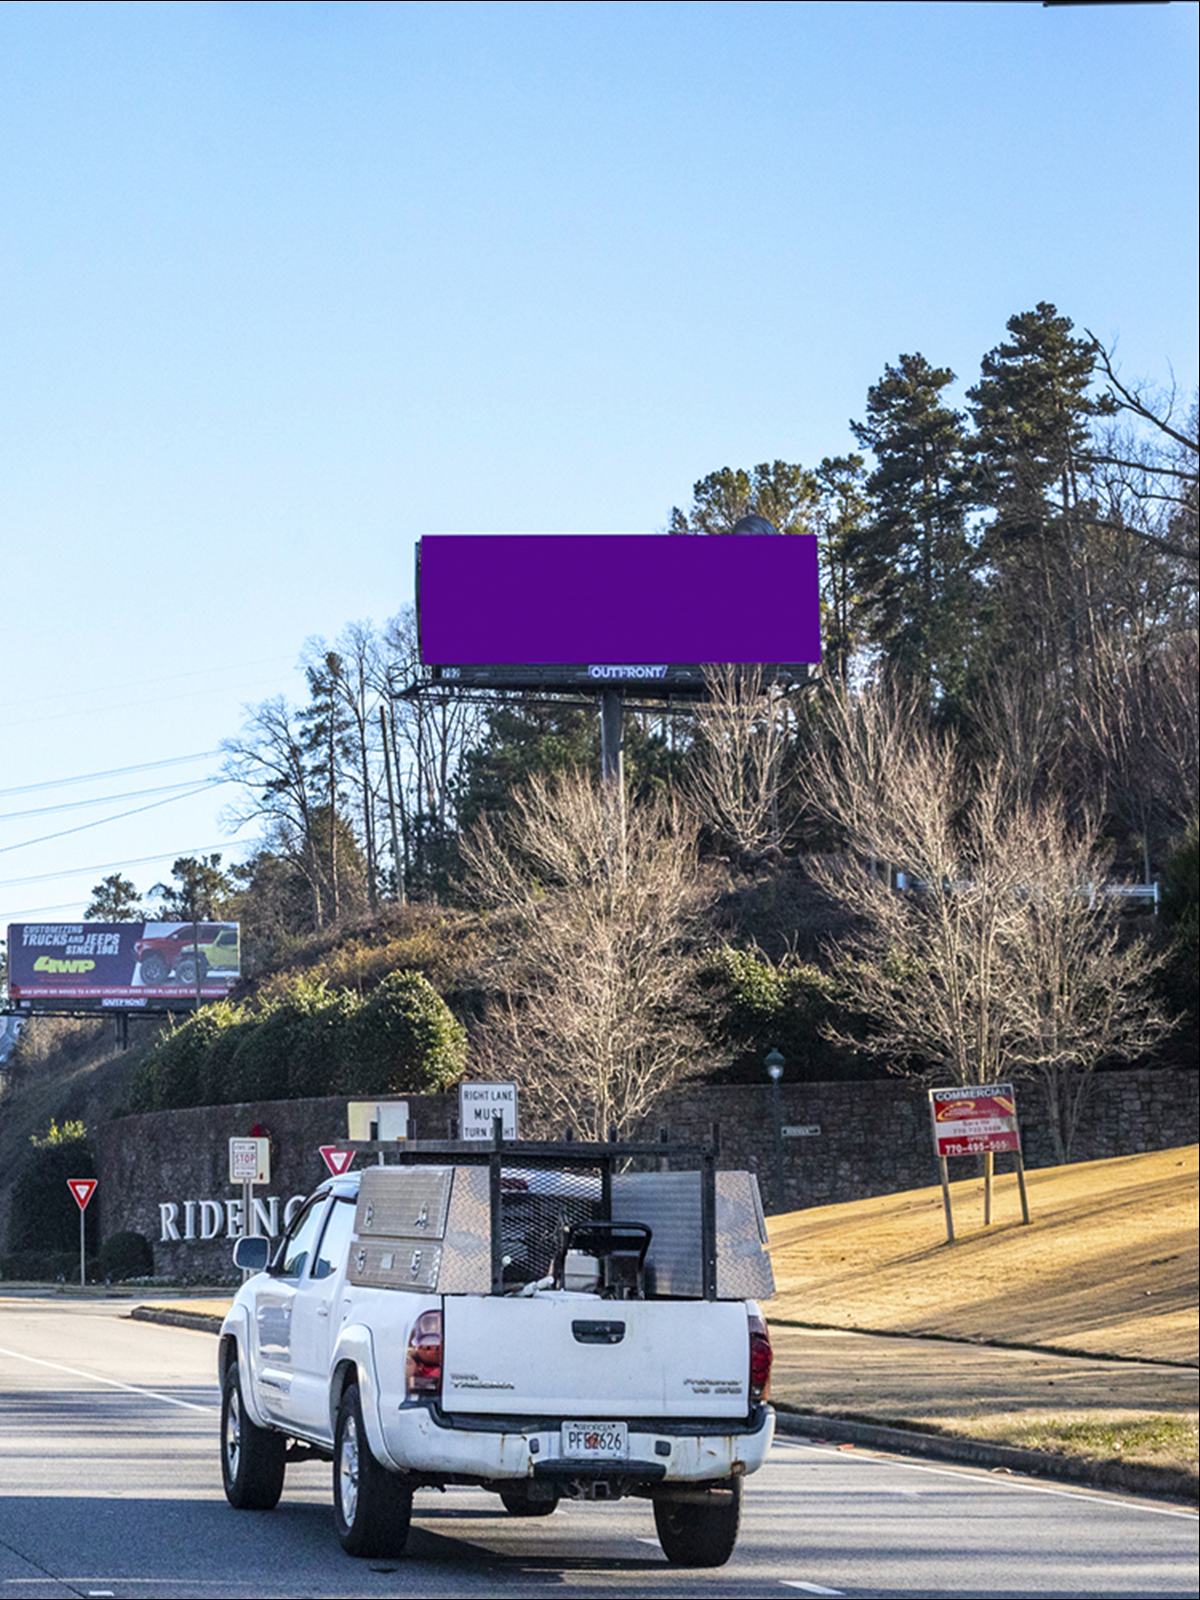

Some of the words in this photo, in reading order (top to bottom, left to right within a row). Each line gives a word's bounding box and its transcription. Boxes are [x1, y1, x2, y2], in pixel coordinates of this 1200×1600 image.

[591, 665, 664, 679] OUTFRONT
[23, 924, 84, 934] CUSTOMIZING
[22, 933, 68, 946] TRUCKS
[68, 935, 85, 944] AND
[85, 933, 120, 946] JEEPS
[65, 945, 94, 955] SINCE
[33, 955, 96, 974] 4WP
[102, 998, 146, 1007] OUTFRONT
[463, 1090, 489, 1101] RIGHT
[491, 1090, 513, 1101] LANE
[935, 1087, 1006, 1102] COMMERCIAL
[474, 1107, 504, 1120] MUST
[465, 1127, 487, 1138] TURN
[490, 1127, 514, 1138] RHT
[234, 1153, 256, 1164] STOP
[576, 1423, 612, 1431] GEORGIA
